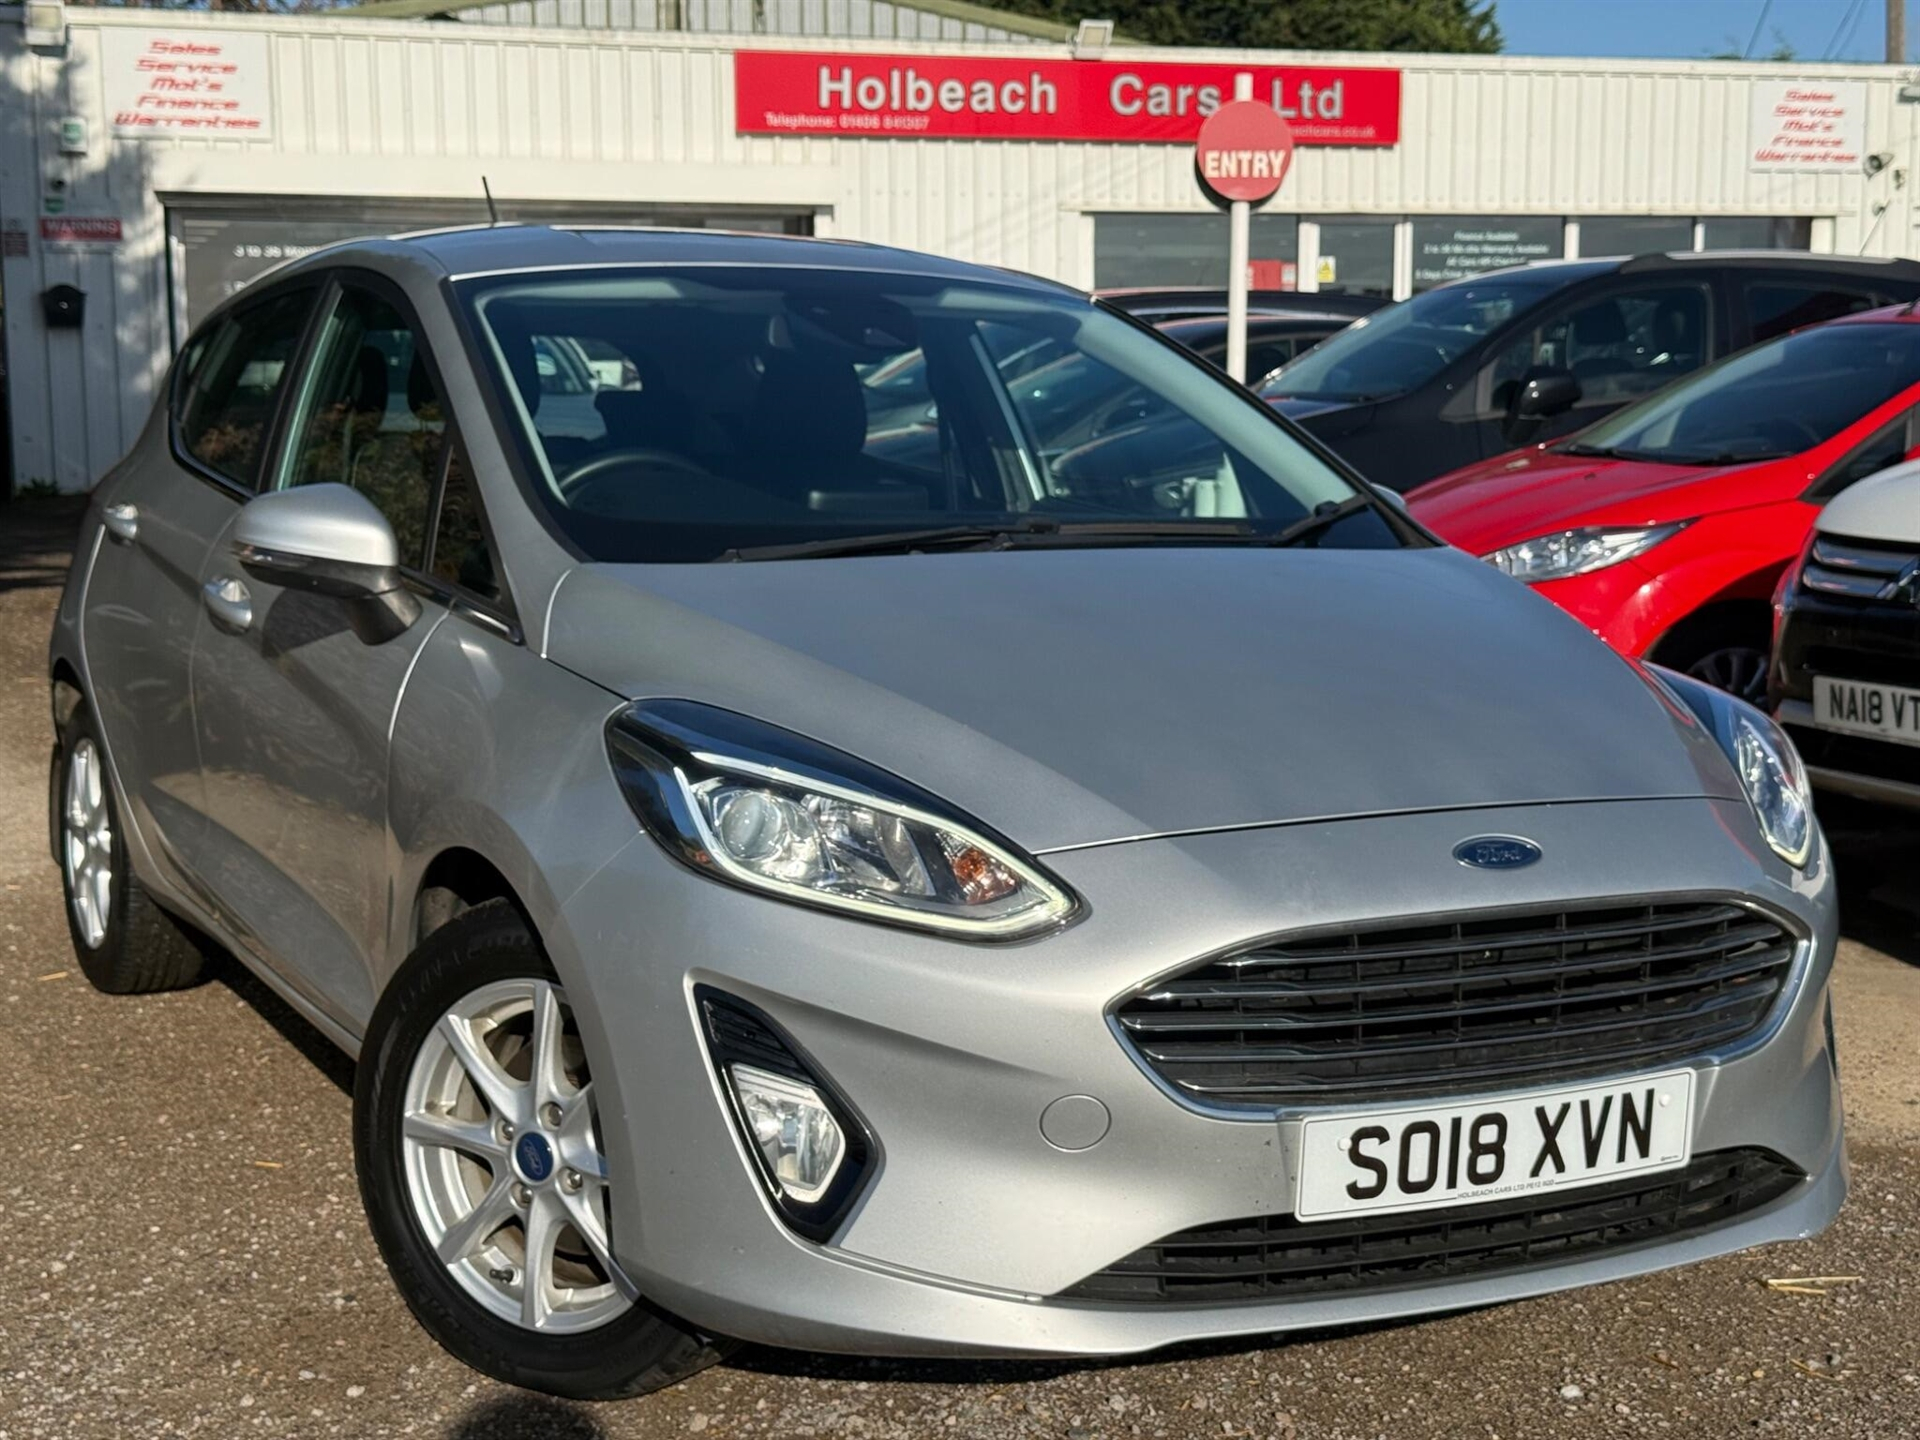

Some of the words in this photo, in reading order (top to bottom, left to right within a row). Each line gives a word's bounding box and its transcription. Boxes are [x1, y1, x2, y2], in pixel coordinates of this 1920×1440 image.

[149, 41, 221, 55] Sales
[135, 59, 238, 74] Service
[818, 65, 1057, 114] Holbeach
[1109, 74, 1222, 117] Cars
[1271, 79, 1344, 120] Ltd
[1784, 90, 1835, 102] Sales
[137, 95, 239, 110] Finance
[1204, 150, 1286, 178] ENTRY
[46, 220, 119, 234] WARNING
[1829, 683, 1883, 725] NA18
[1345, 1111, 1508, 1200] SO18
[1529, 1088, 1655, 1178] XVN
[1457, 1188, 1493, 1199] HOLBEACH
[1494, 1185, 1512, 1194] CARS
[1513, 1183, 1525, 1192] LTD
